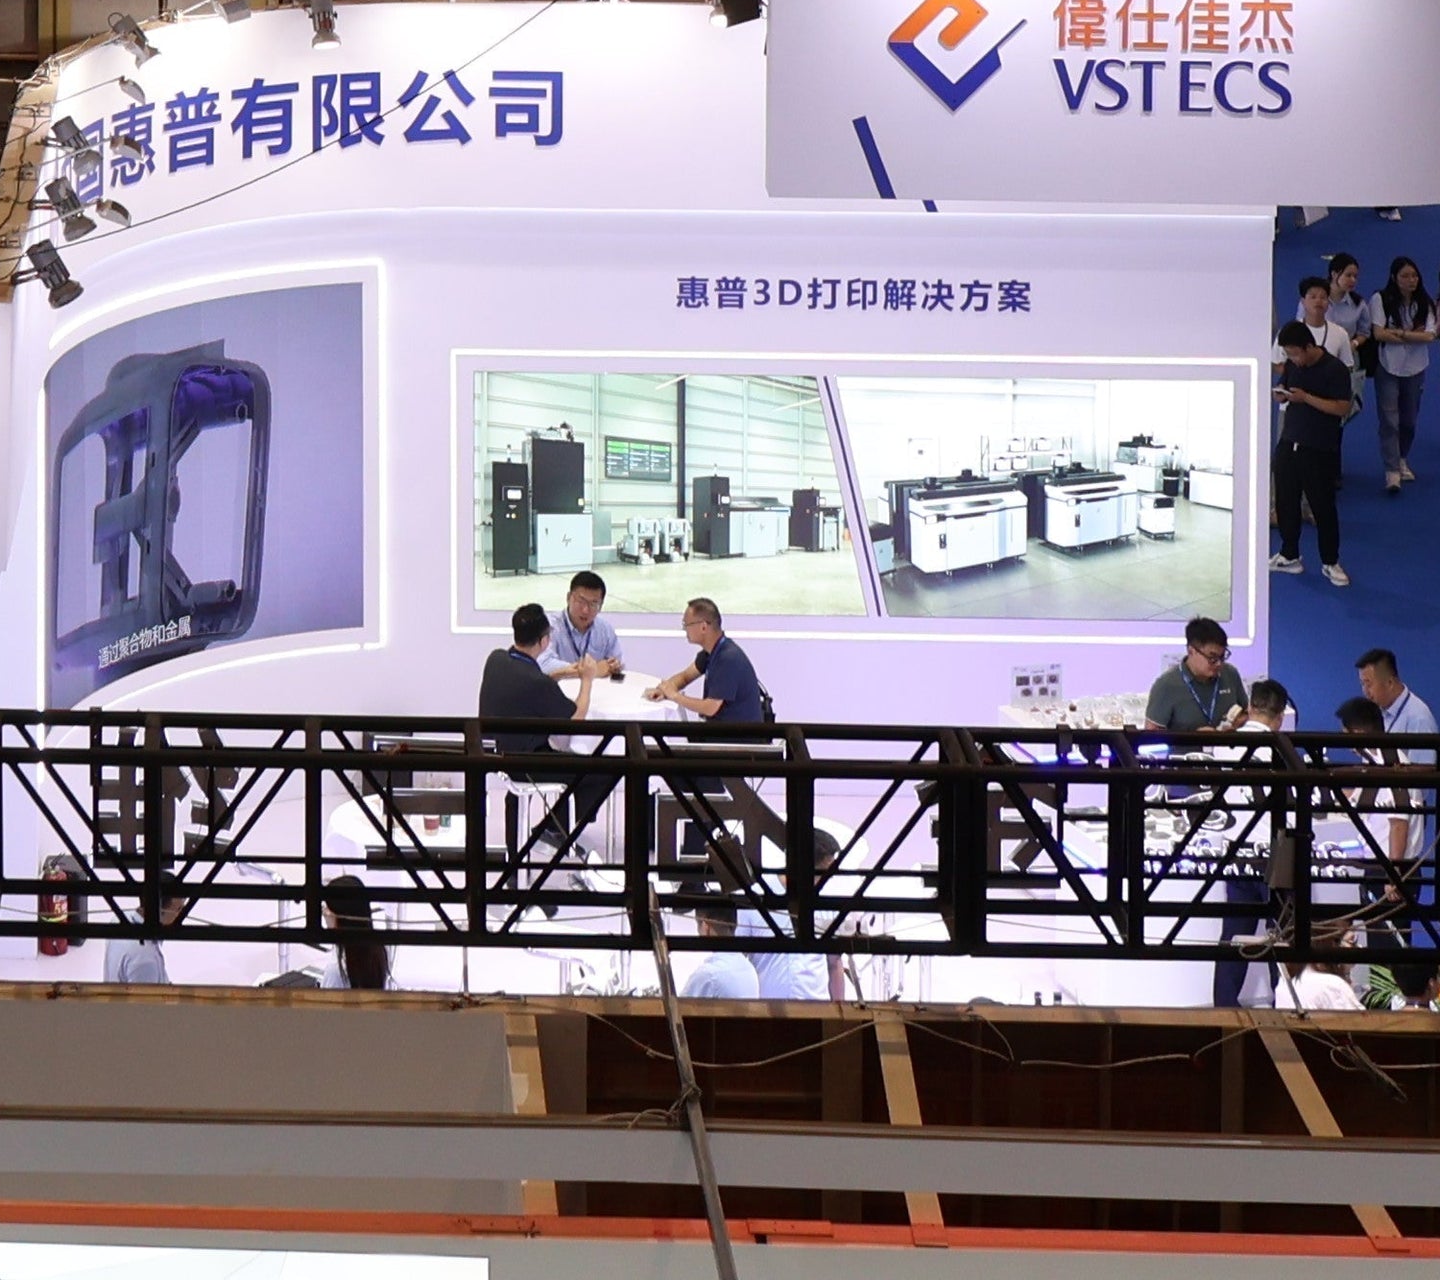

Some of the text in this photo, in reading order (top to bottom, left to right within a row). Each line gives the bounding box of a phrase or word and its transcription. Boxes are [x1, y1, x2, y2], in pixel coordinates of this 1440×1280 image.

[1053, 59, 1294, 115] VSTECS
[675, 275, 1033, 315] 惠普3D打印解决方案
[98, 615, 192, 670] 通过聚合物和金属
